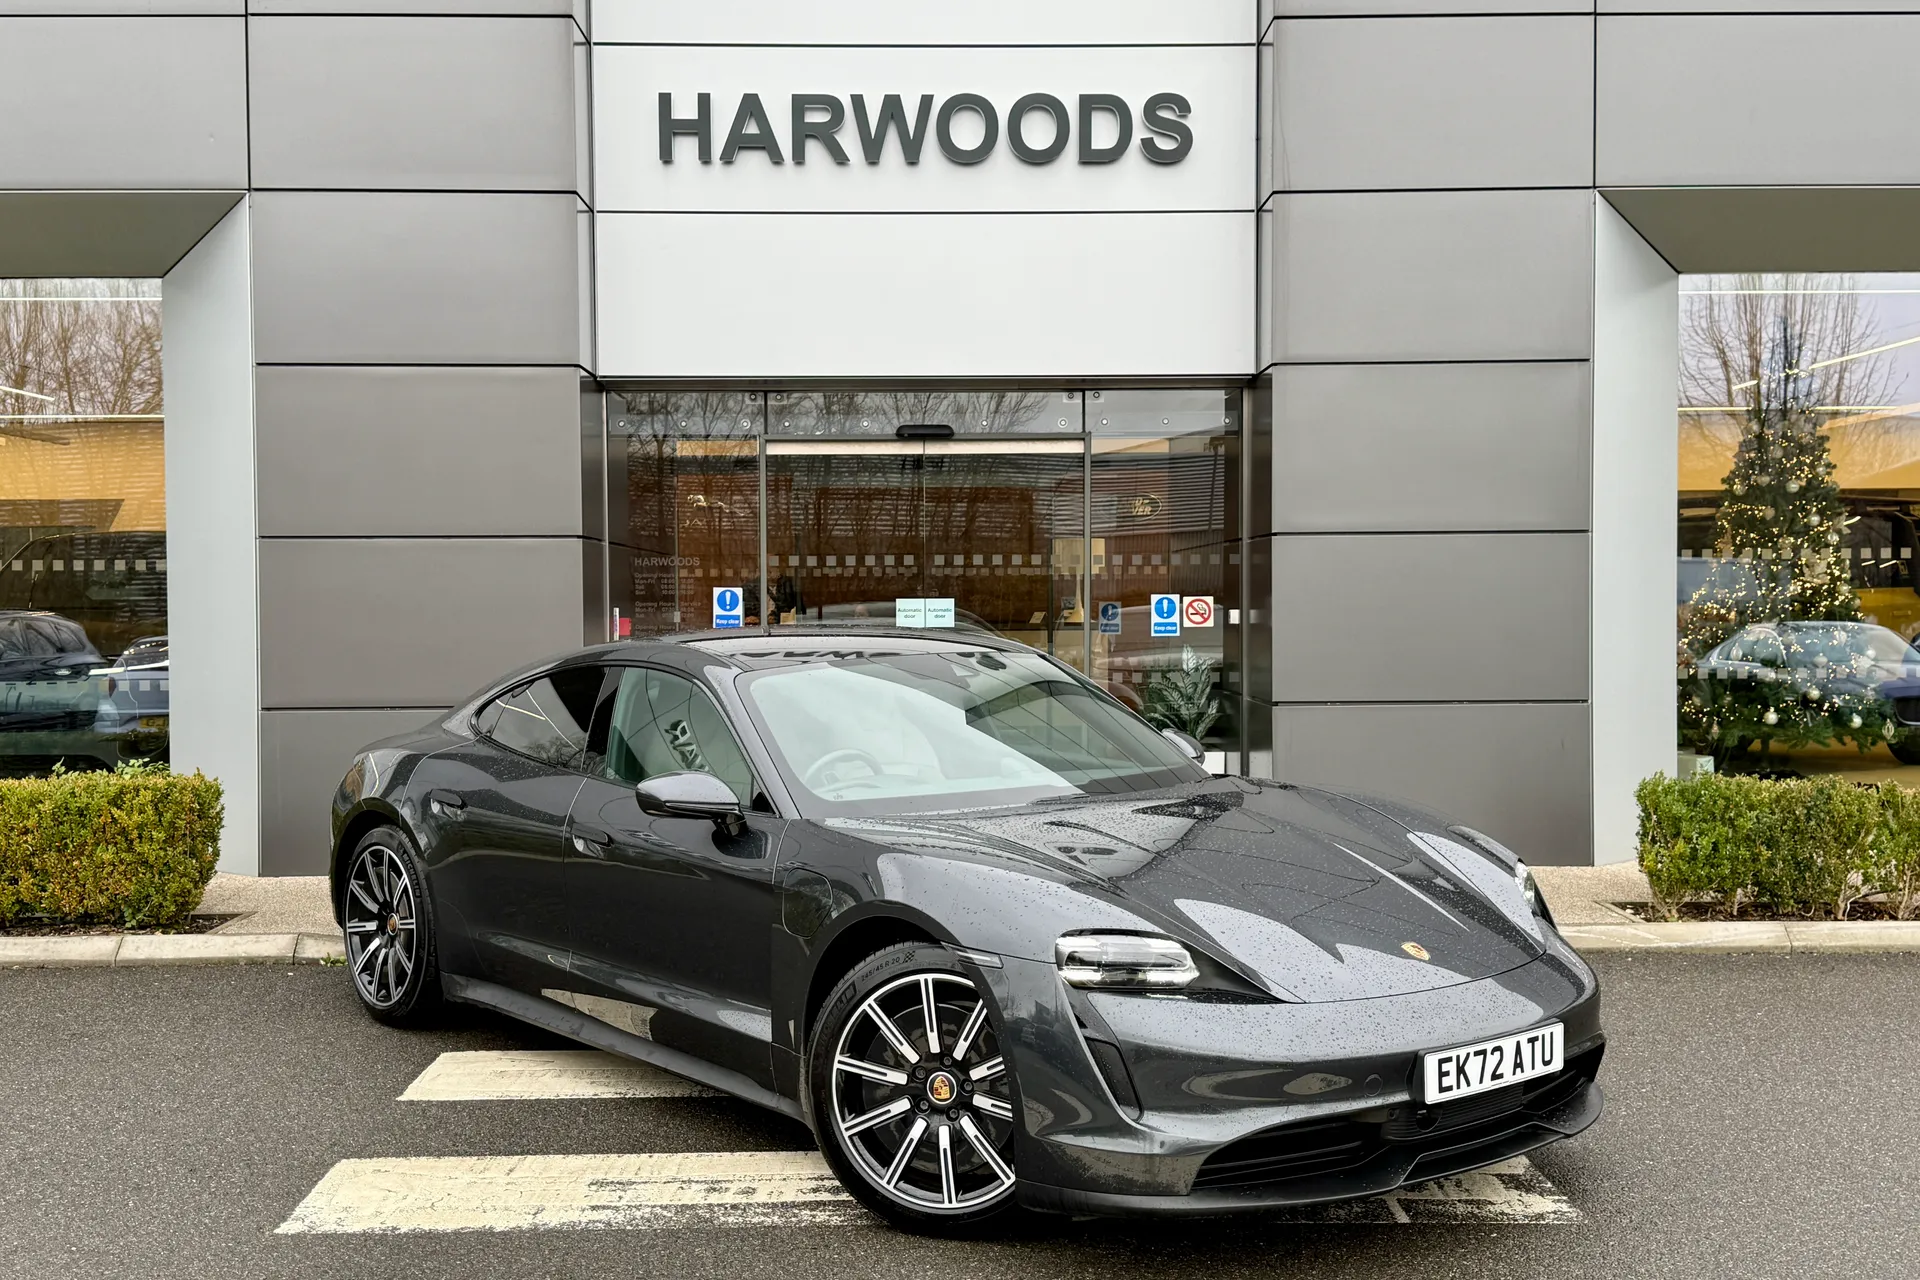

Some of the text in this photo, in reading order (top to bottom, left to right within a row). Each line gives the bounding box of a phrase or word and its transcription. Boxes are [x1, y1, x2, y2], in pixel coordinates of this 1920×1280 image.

[658, 92, 1194, 164] HARWOODS
[634, 557, 700, 566] HARWOODS
[861, 963, 884, 981] 245/45
[891, 956, 900, 964] 20
[1438, 1031, 1554, 1094] EK72 ATU
